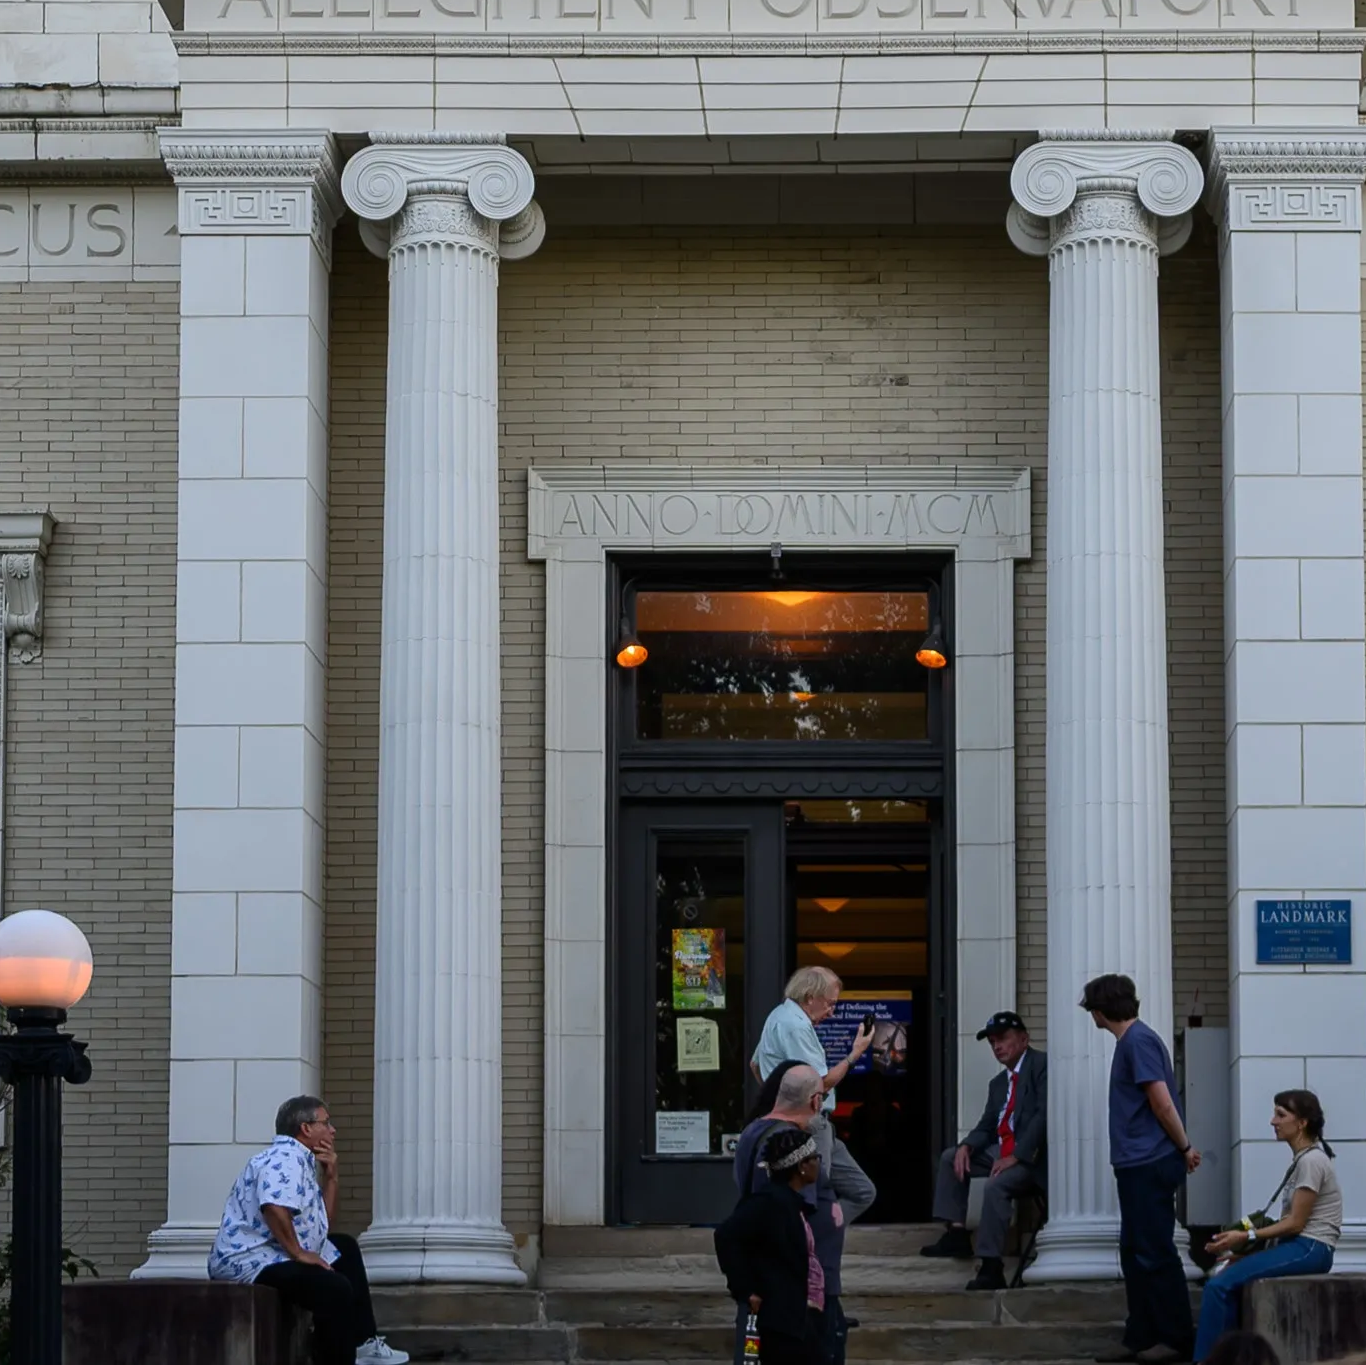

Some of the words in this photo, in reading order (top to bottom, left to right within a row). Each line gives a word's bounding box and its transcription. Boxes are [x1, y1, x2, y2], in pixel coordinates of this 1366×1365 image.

[558, 492, 699, 537] ANNO
[714, 493, 875, 537] DOMINI
[882, 492, 1005, 537] MCM
[1276, 901, 1332, 910] HISTORIC
[1260, 910, 1348, 924] LANDMARK
[875, 1002, 888, 1010] the
